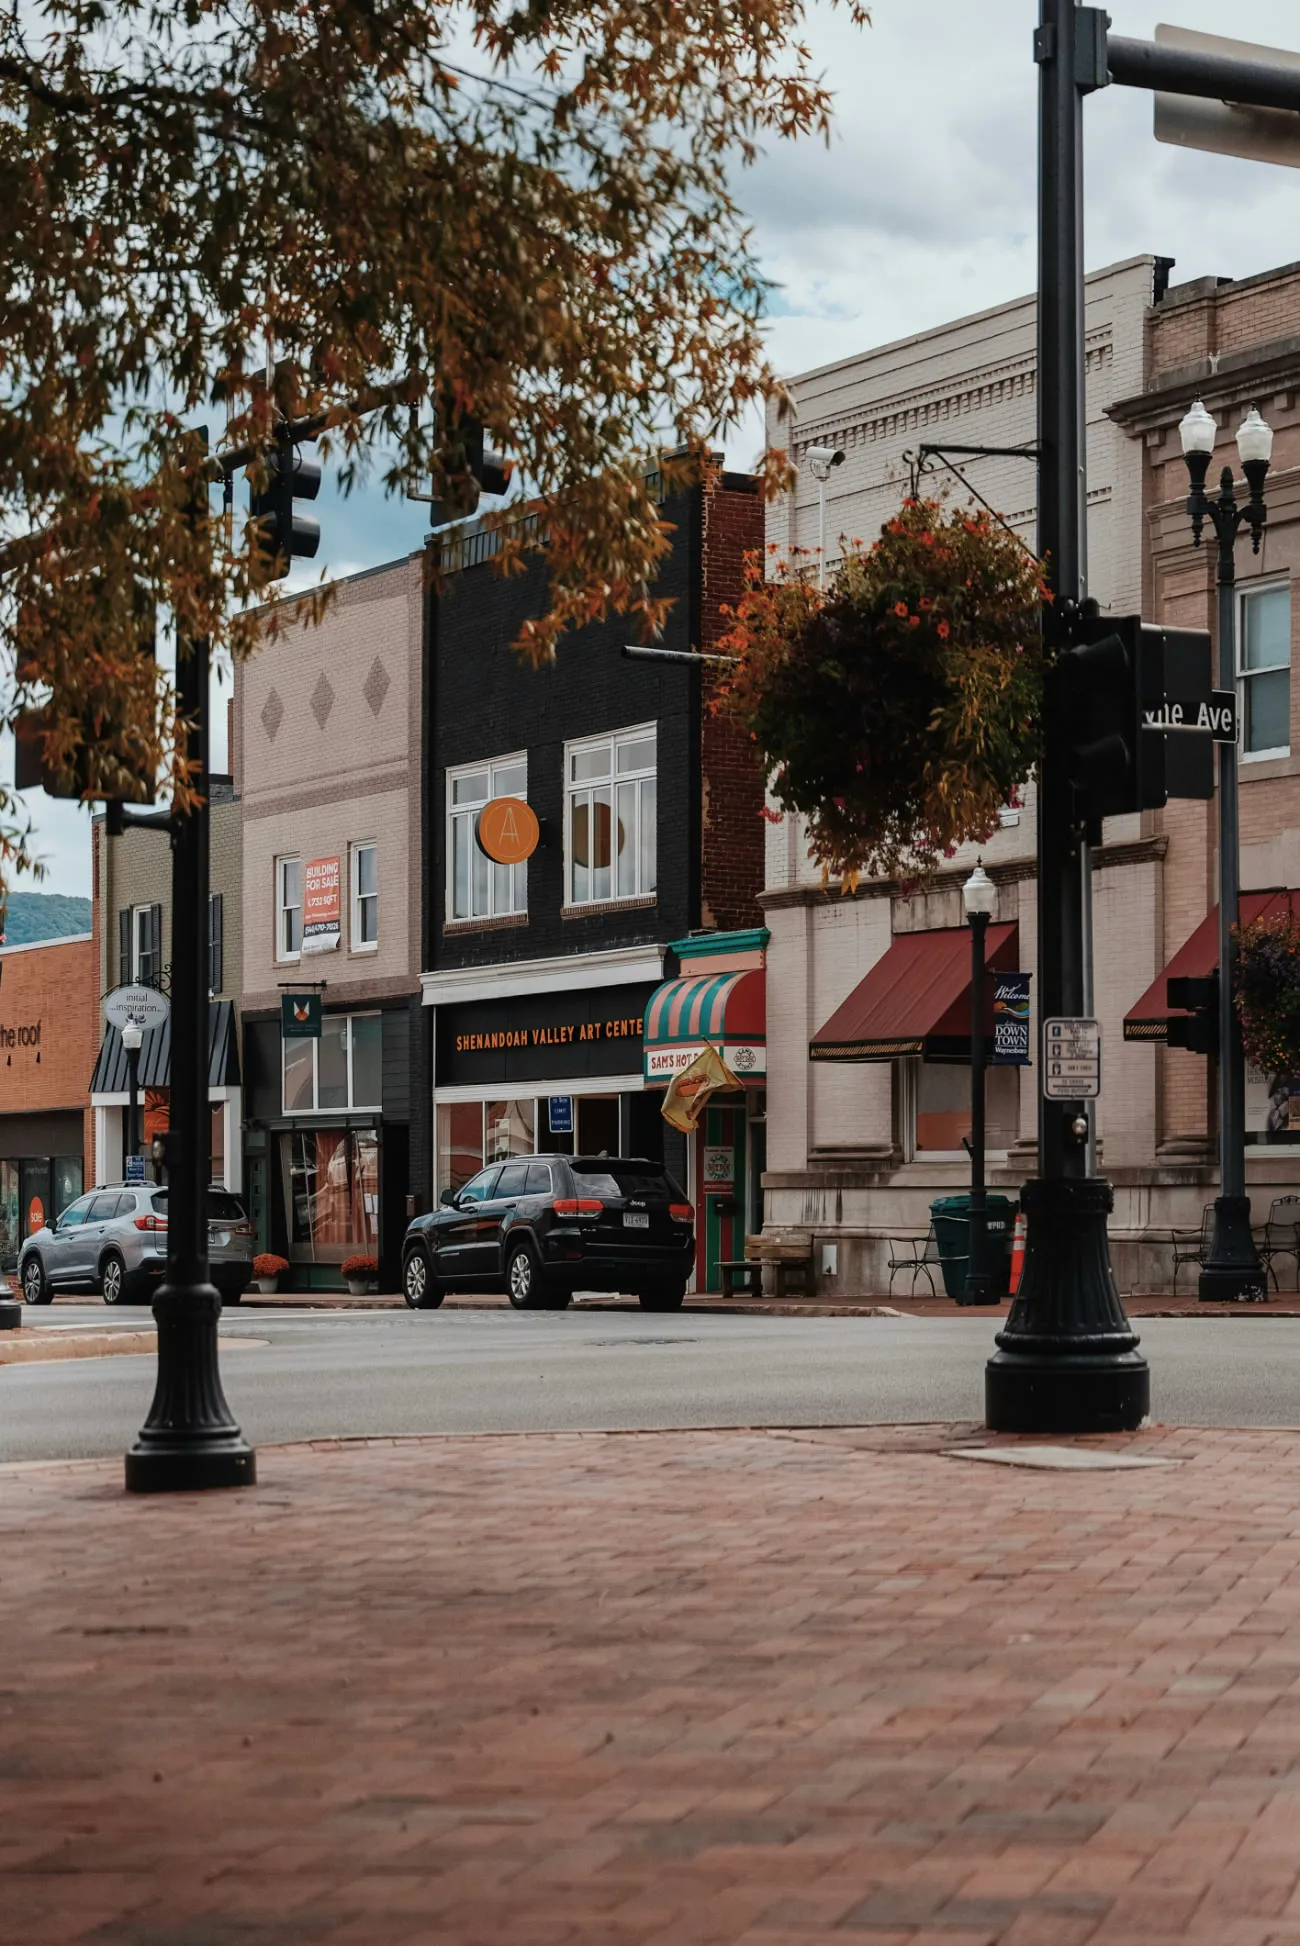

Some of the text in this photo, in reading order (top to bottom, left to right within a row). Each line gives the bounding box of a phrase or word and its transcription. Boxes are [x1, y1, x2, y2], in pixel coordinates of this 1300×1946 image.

[1197, 702, 1232, 732] Ave
[306, 863, 338, 878] BUILDING
[306, 875, 339, 891] FOR SALE
[126, 993, 148, 1002] initial
[995, 984, 1030, 1000] Welcome
[0, 1019, 42, 1048] he roof
[456, 1018, 644, 1051] SHENANDOAH VALLEY ART CENTE
[995, 1026, 1028, 1036] DOWN
[995, 1036, 1028, 1046] TOWN
[651, 1054, 674, 1070] SAM'S
[629, 1199, 646, 1208] Jeep
